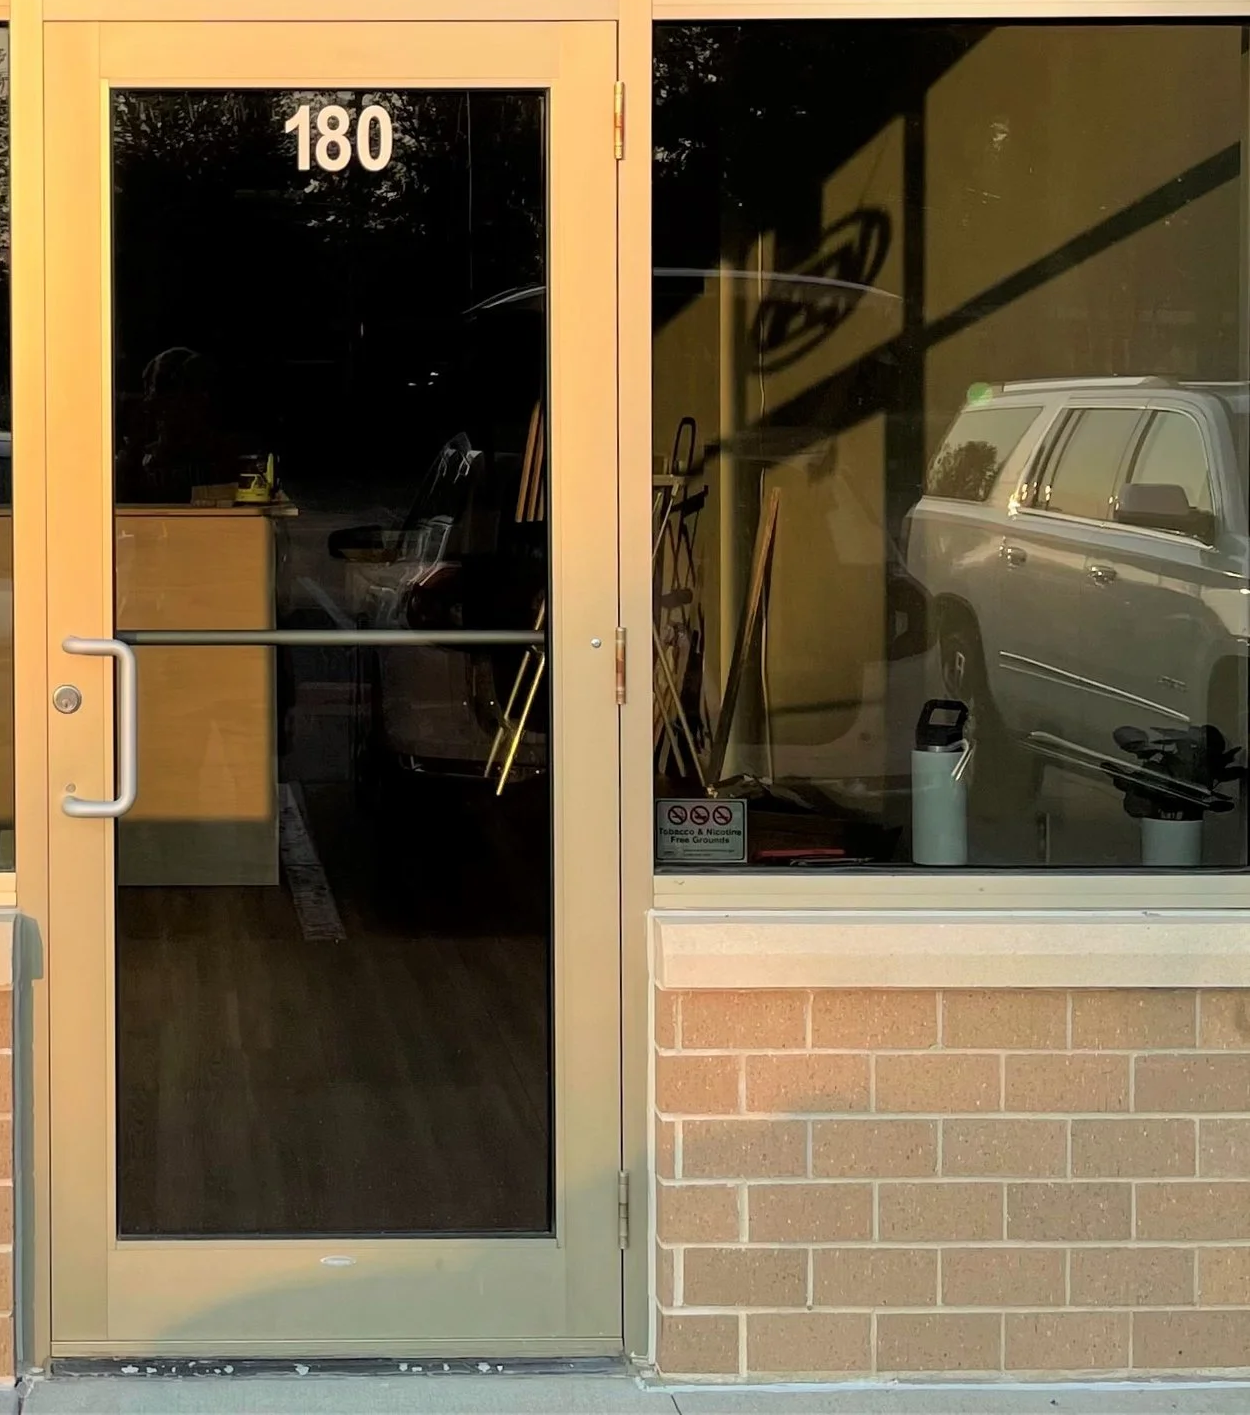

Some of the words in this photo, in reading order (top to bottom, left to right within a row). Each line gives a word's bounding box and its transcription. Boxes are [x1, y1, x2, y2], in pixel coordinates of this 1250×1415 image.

[284, 104, 393, 172] 180
[659, 828, 695, 836] Tobacco
[697, 828, 704, 836] &
[706, 828, 742, 837] Nicotine
[670, 836, 690, 844] Free
[692, 836, 730, 844] Grounds
